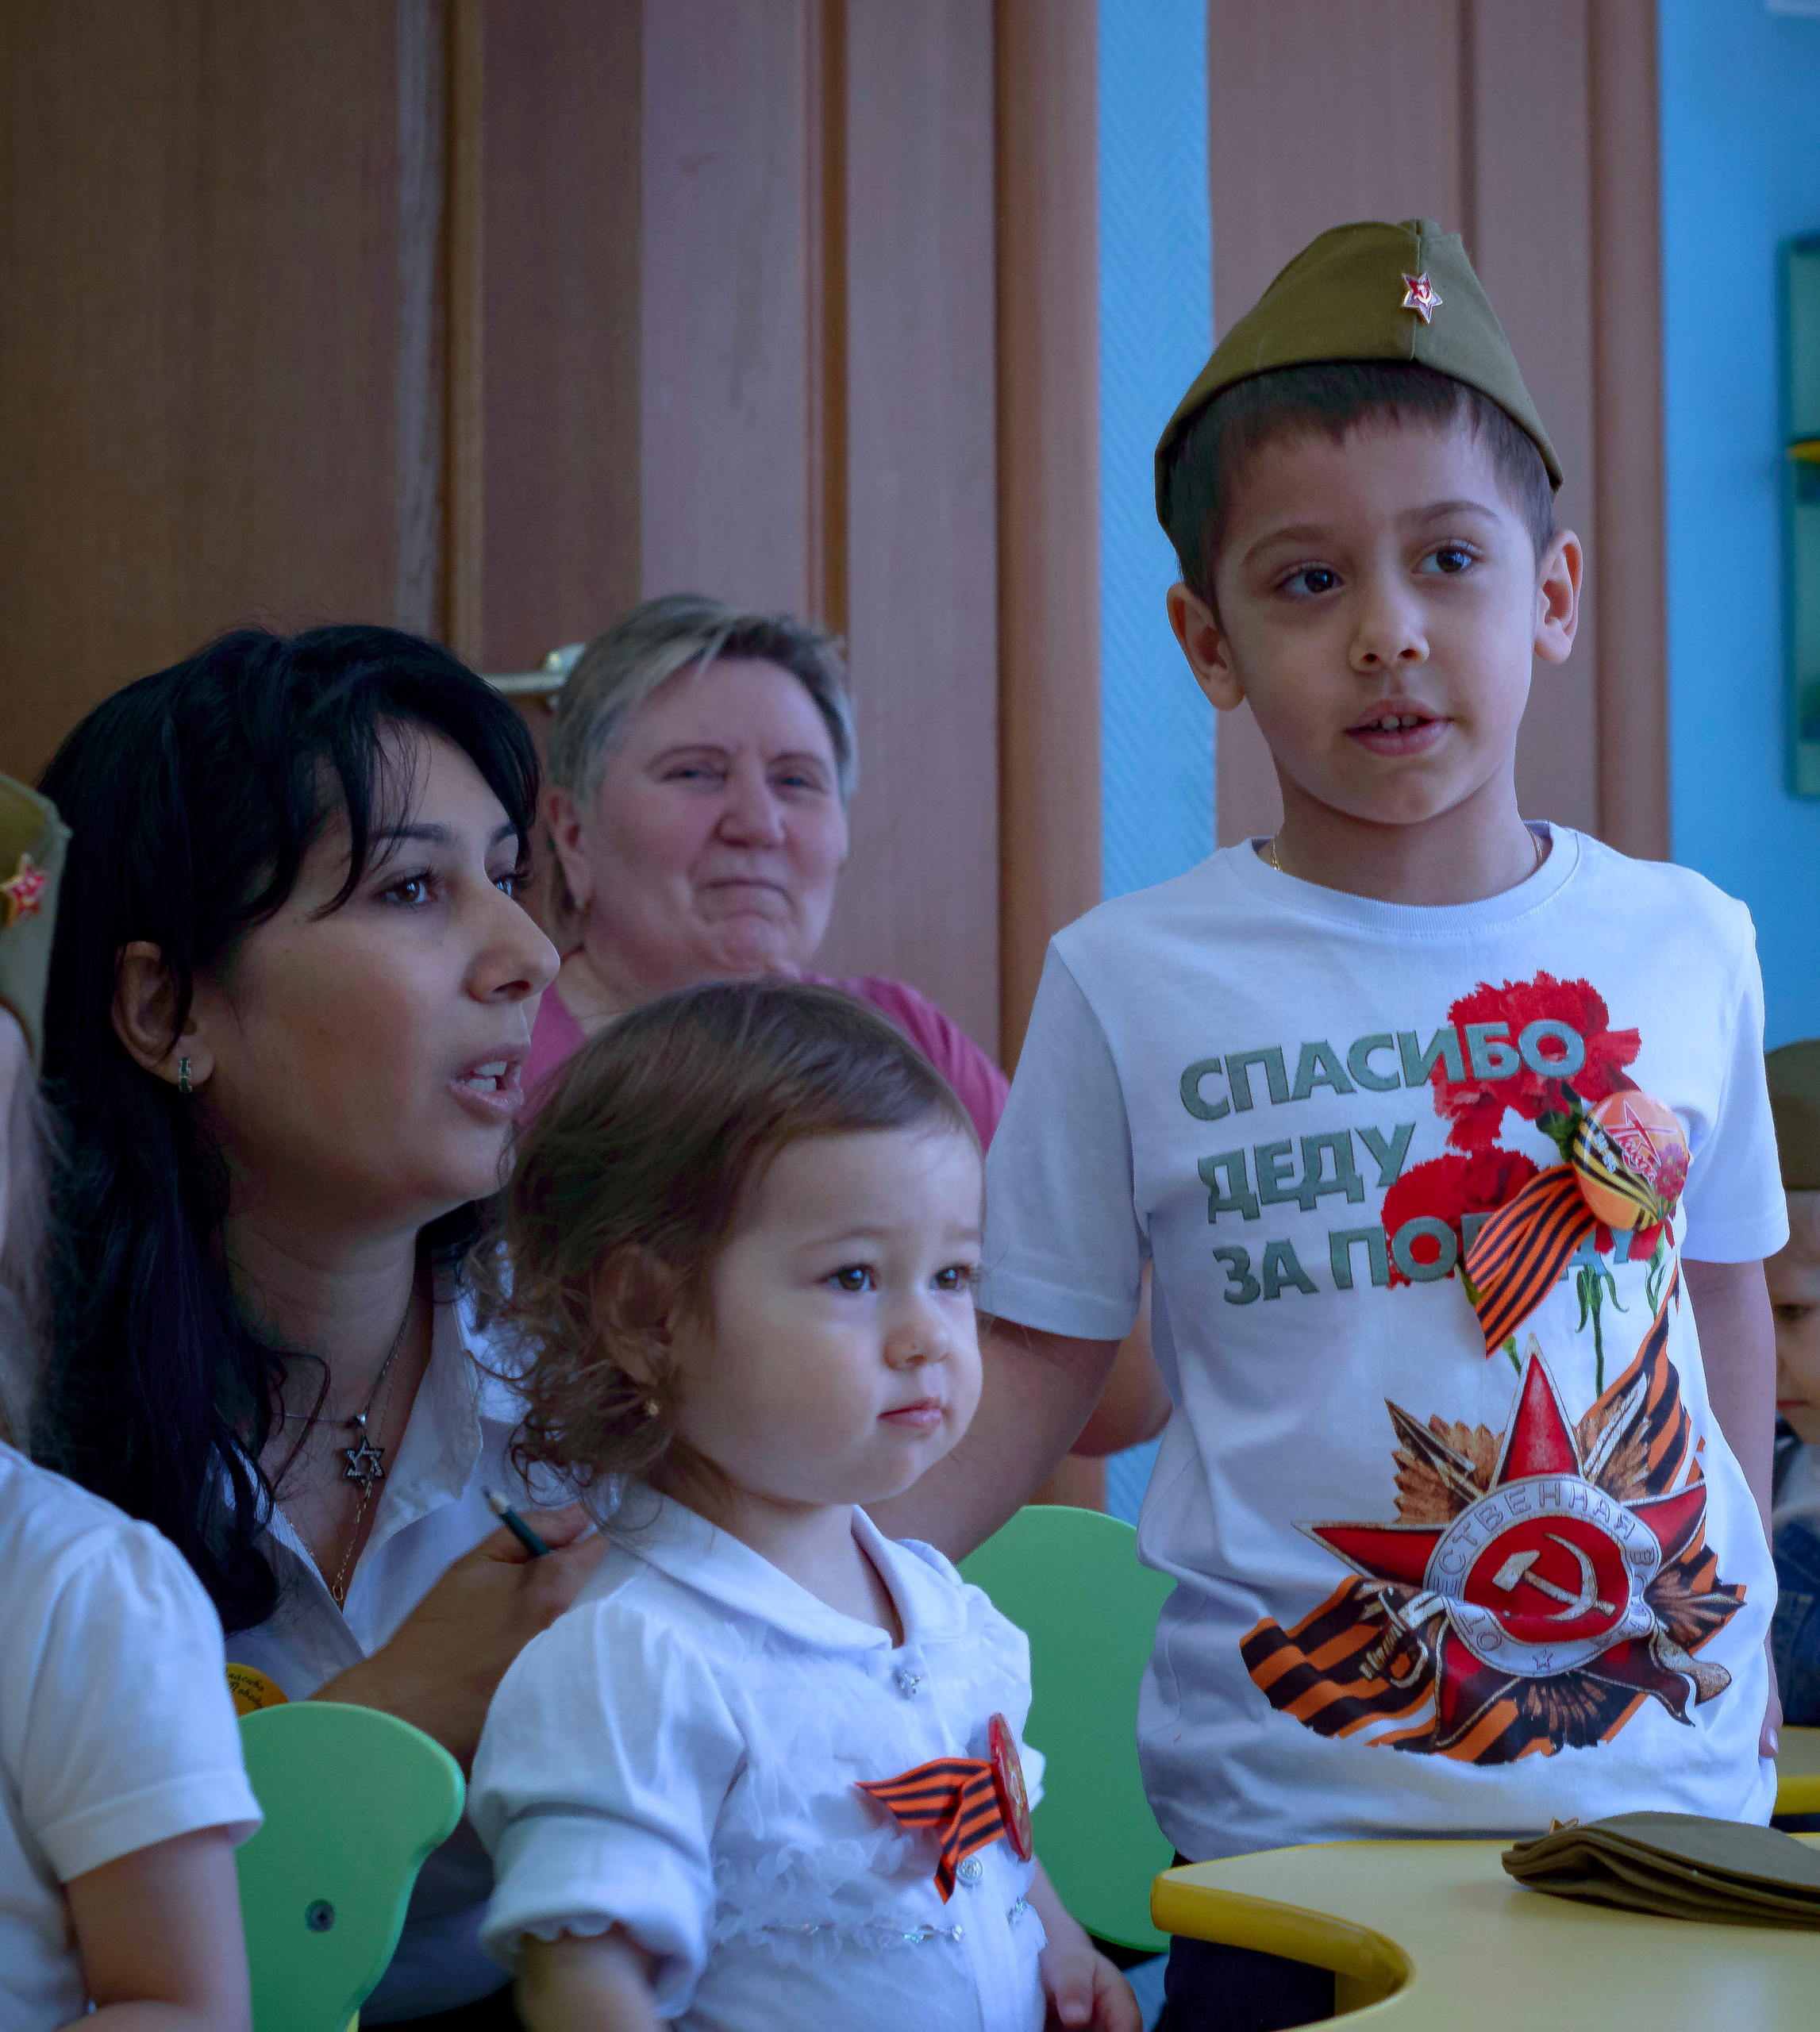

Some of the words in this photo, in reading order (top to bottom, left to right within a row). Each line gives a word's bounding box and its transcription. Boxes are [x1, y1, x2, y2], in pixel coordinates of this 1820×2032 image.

[1179, 1018, 1587, 1122] СПАСИБО
[1197, 1122, 1417, 1226] ДЕДУ
[1212, 1237, 1319, 1307] ЗА
